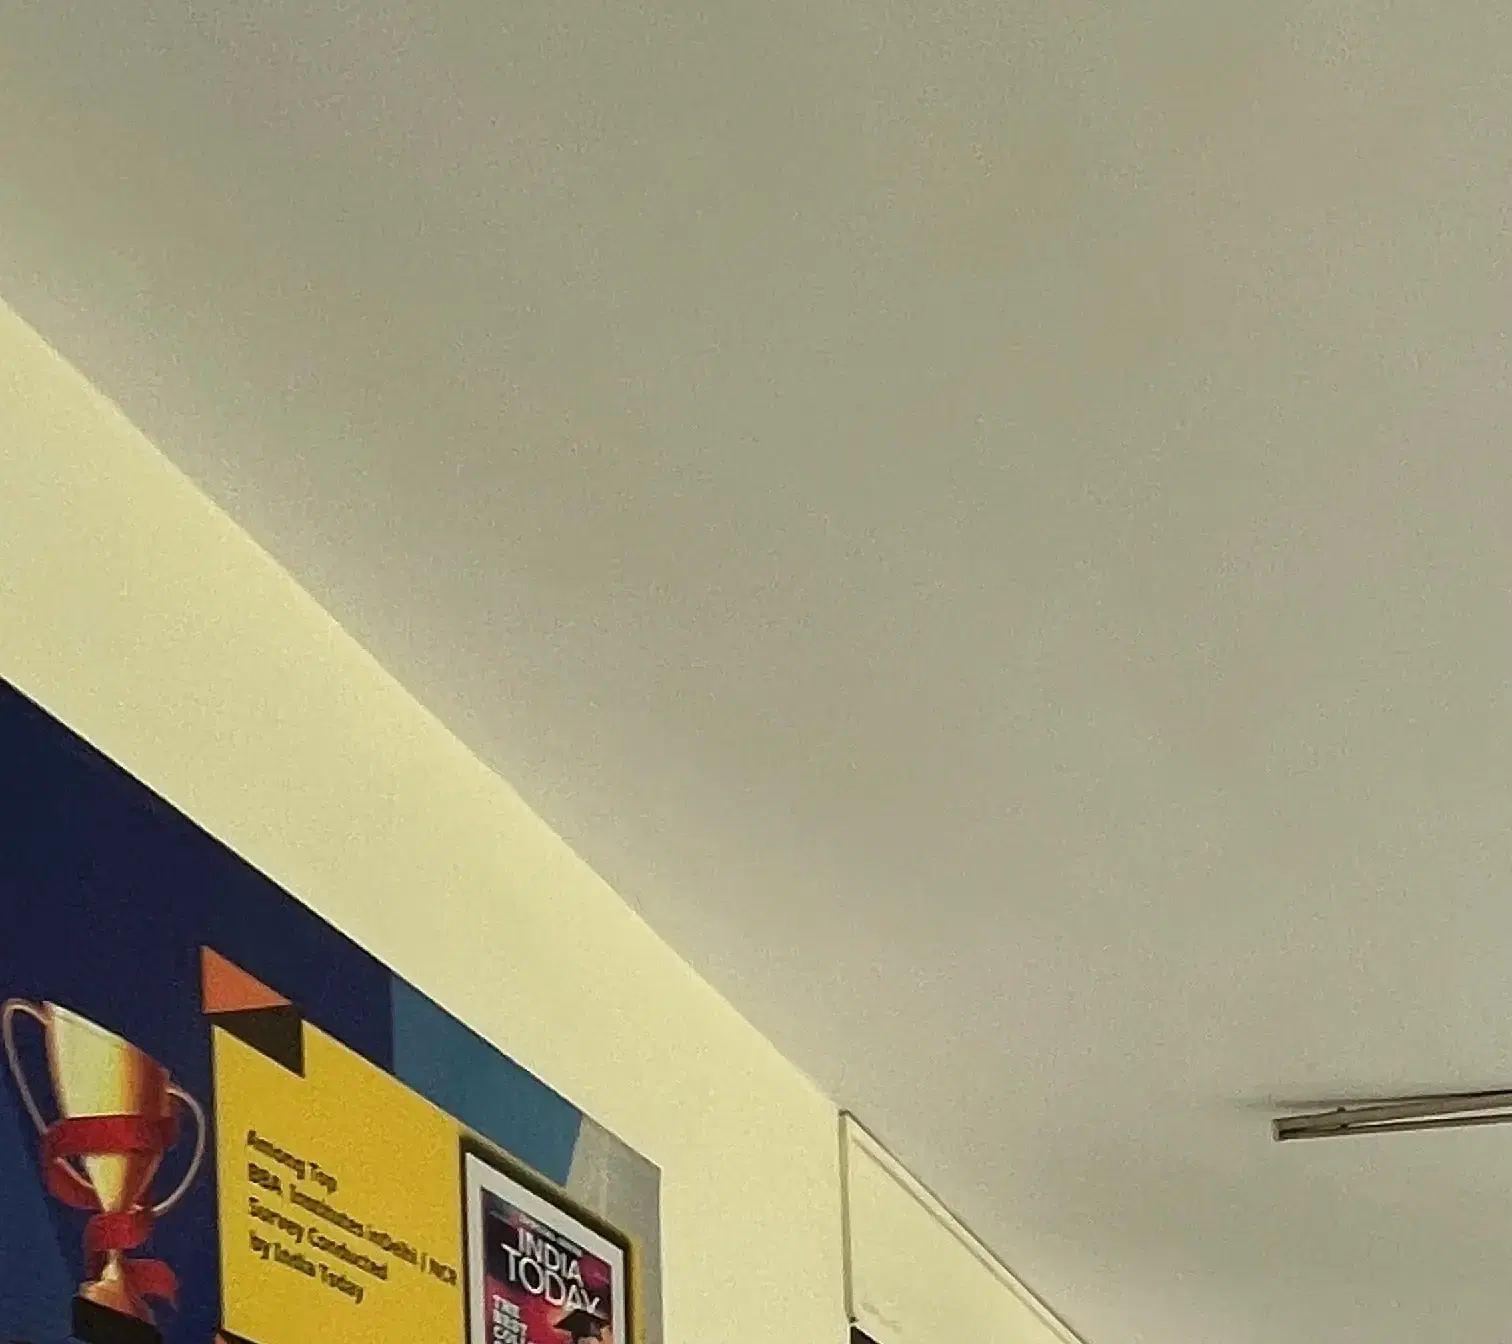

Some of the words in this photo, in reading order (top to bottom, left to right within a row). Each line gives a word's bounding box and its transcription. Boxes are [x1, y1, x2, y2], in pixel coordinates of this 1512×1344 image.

[247, 1129, 305, 1180] Among
[309, 1161, 337, 1192] Top
[248, 1197, 305, 1243] Survey
[308, 1227, 388, 1280] Conducted
[249, 1229, 269, 1260] by
[274, 1242, 316, 1277] India
[318, 1263, 363, 1304] Today
[517, 1227, 584, 1287] INDIA
[501, 1243, 601, 1313] TODAY
